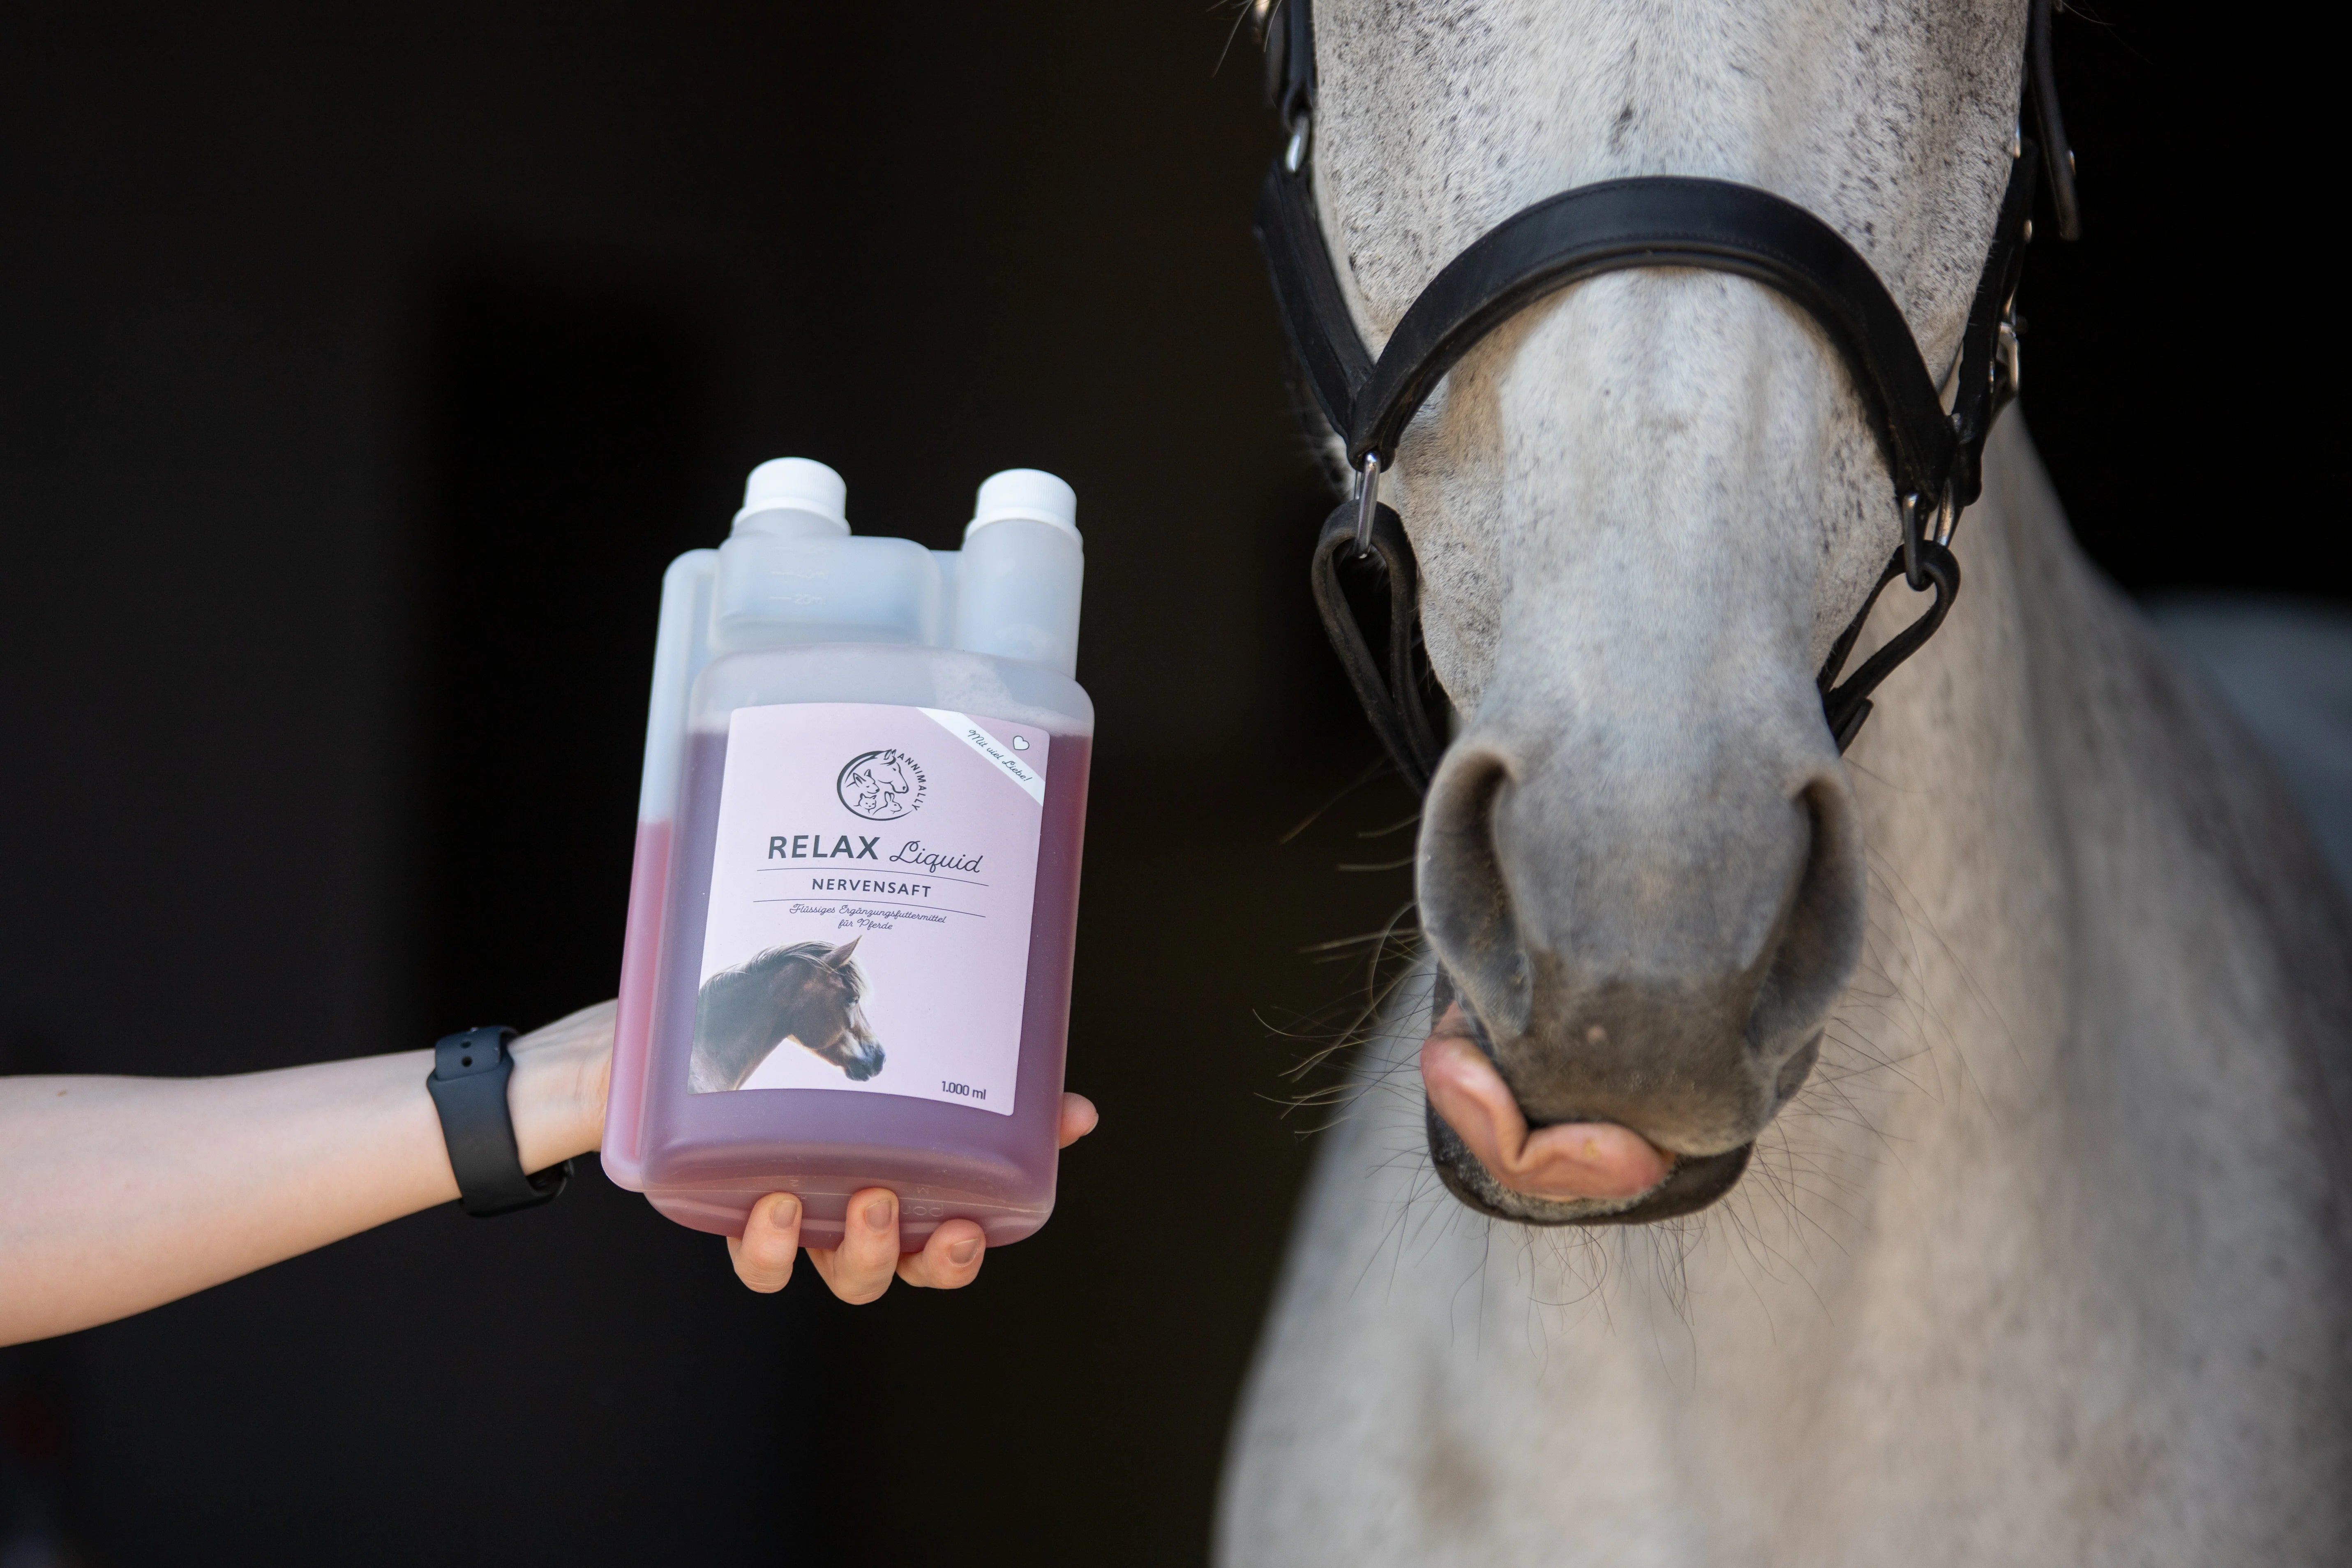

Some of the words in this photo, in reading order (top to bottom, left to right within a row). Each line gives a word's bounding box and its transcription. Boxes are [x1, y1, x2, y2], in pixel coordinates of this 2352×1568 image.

[968, 730, 988, 747] Mit
[987, 748, 1004, 760] viel
[1002, 761, 1032, 781] Liebe!
[897, 753, 927, 811] ANNIMALLY
[768, 835, 880, 860] RELAX
[889, 841, 983, 873] Liquid
[812, 878, 931, 897] NERVENSAFT
[789, 903, 836, 914] Flüssiges
[839, 905, 947, 924] Ergänzungsfuttermittel
[838, 919, 854, 929] für
[857, 918, 893, 931] Pferde
[942, 1081, 970, 1096] 1.000
[972, 1089, 986, 1100] ml
